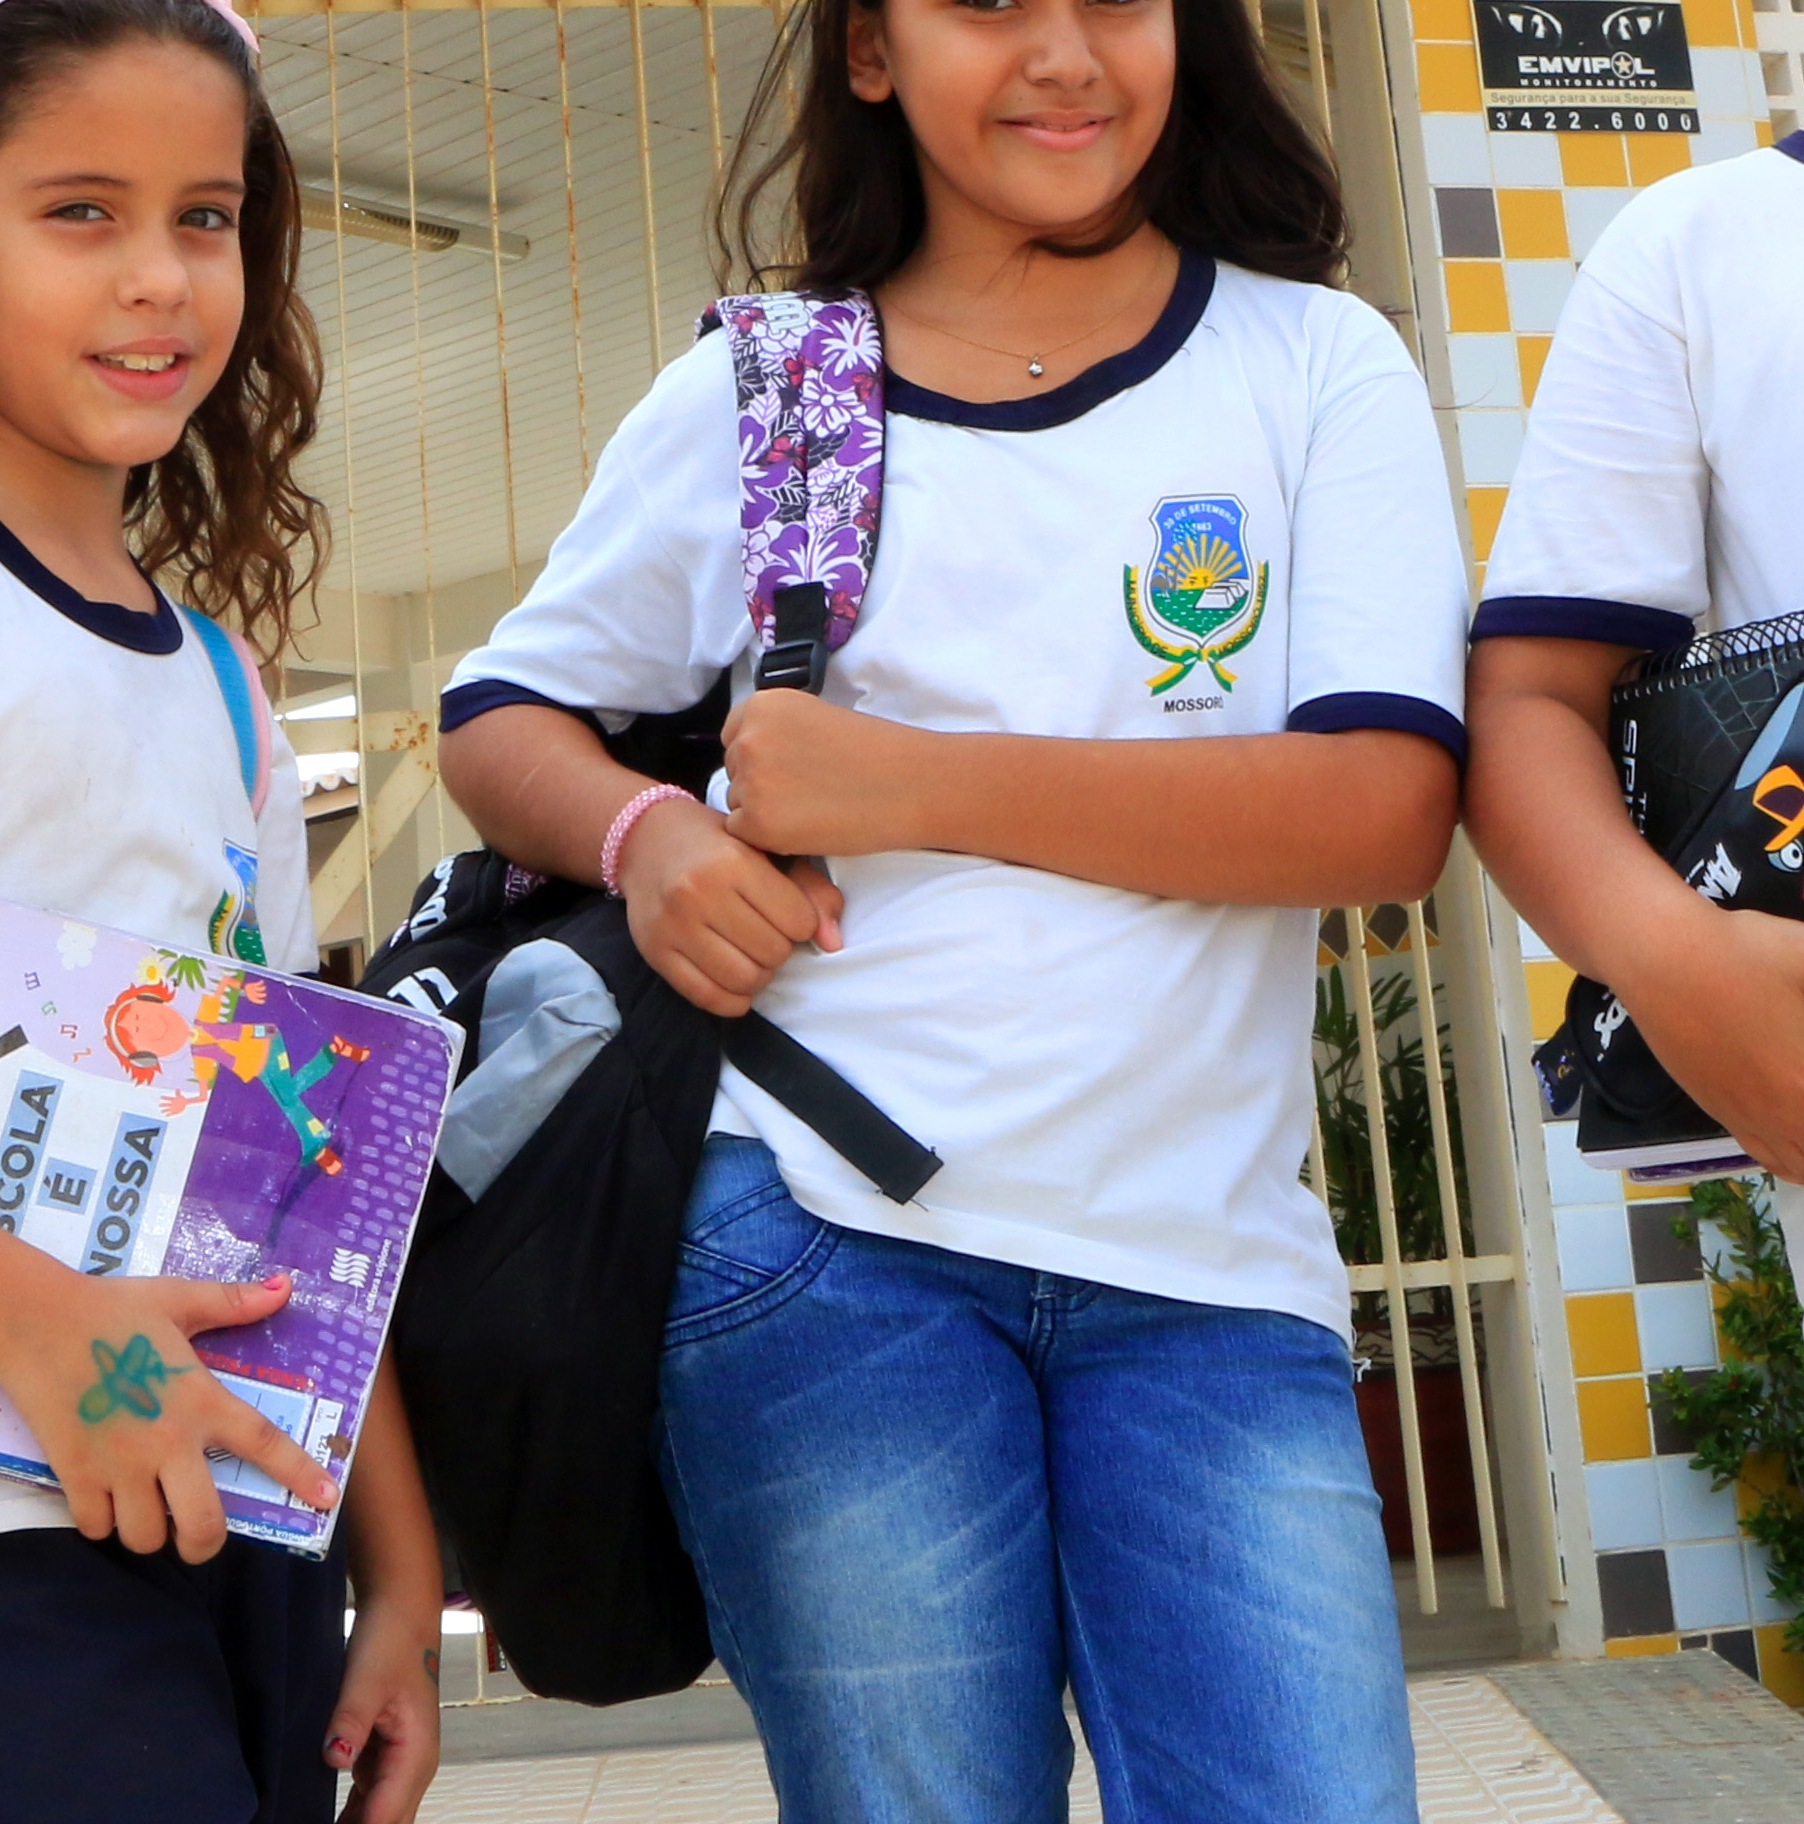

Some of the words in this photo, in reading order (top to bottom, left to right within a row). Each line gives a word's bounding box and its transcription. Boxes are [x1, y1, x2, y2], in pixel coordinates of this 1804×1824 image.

[1519, 78, 1658, 89] MONITORAMENTO
[1491, 92, 1556, 105] Segurança
[1560, 93, 1586, 105] para
[1601, 94, 1621, 103] sua
[1188, 503, 1237, 525] SETEMBRO
[44, 1172, 88, 1207] É
[85, 1126, 162, 1276] NOSSA
